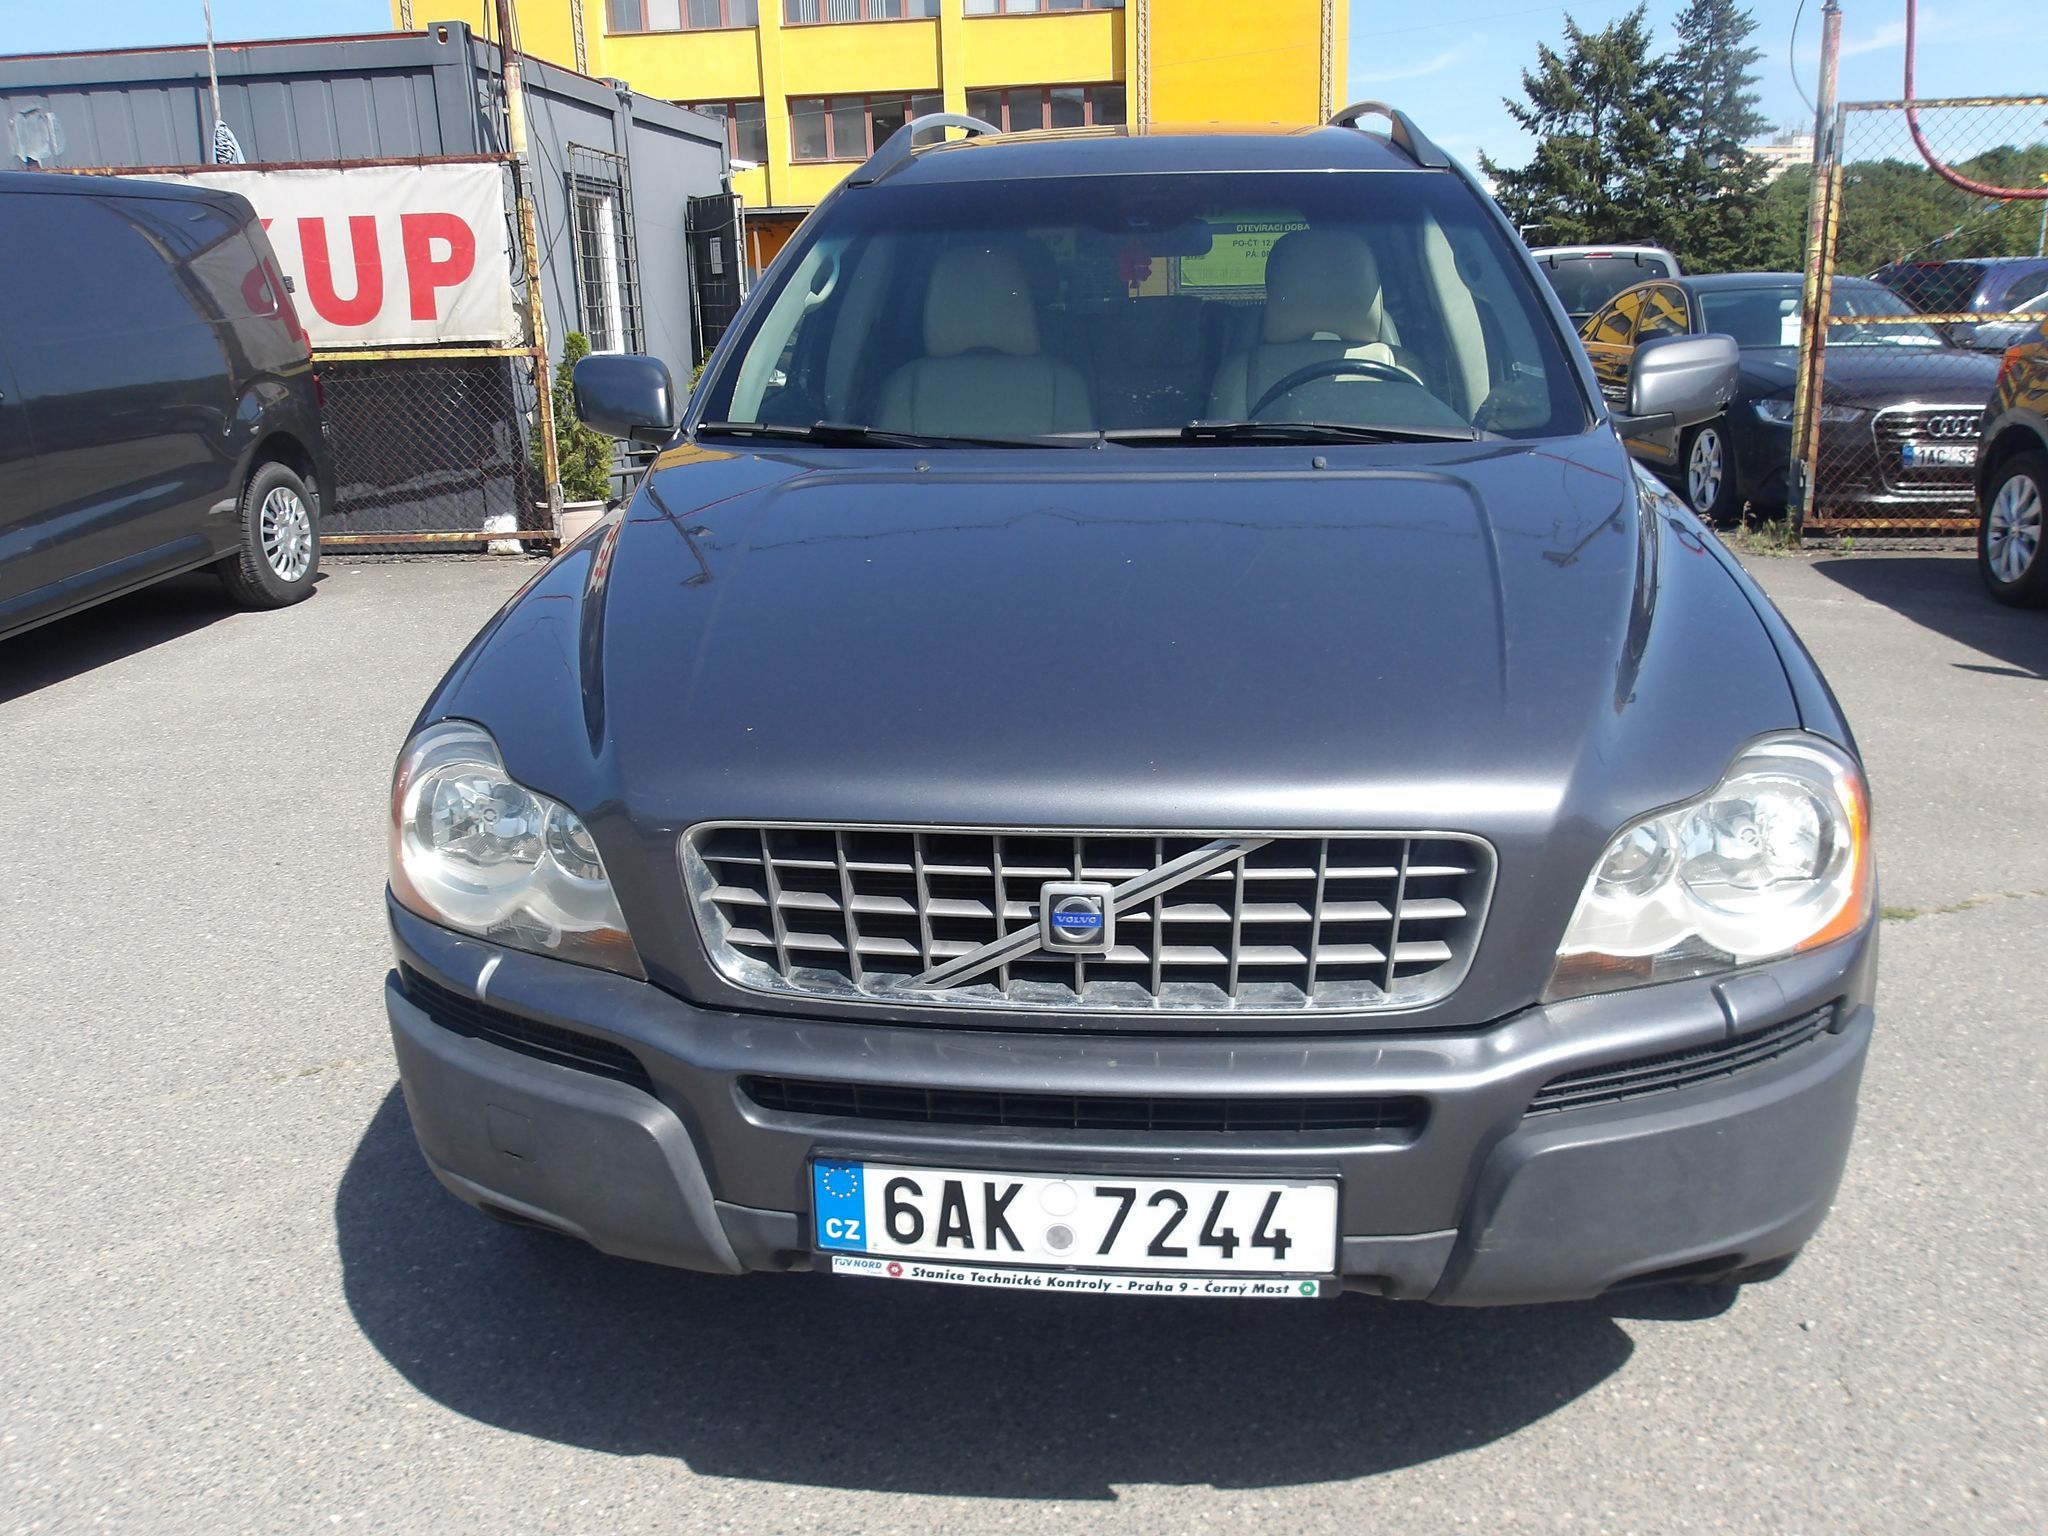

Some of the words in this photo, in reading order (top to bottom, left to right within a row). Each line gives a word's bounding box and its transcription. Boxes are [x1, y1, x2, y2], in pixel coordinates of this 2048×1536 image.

[1284, 223, 1311, 231] DOBA
[260, 213, 475, 327] UP
[1056, 915, 1097, 924] VOLVO
[826, 1217, 861, 1240] CZ
[885, 1176, 1025, 1252] 6AK
[1095, 1186, 1292, 1260] 7244
[853, 1260, 882, 1270] NORD
[912, 1267, 964, 1281] Stanice
[972, 1272, 1042, 1287] Technické
[1047, 1277, 1111, 1291] Kontroly
[1128, 1280, 1174, 1292] Praha
[1179, 1282, 1189, 1292] 9
[1204, 1280, 1247, 1294] Černý
[1252, 1284, 1290, 1294] Most
